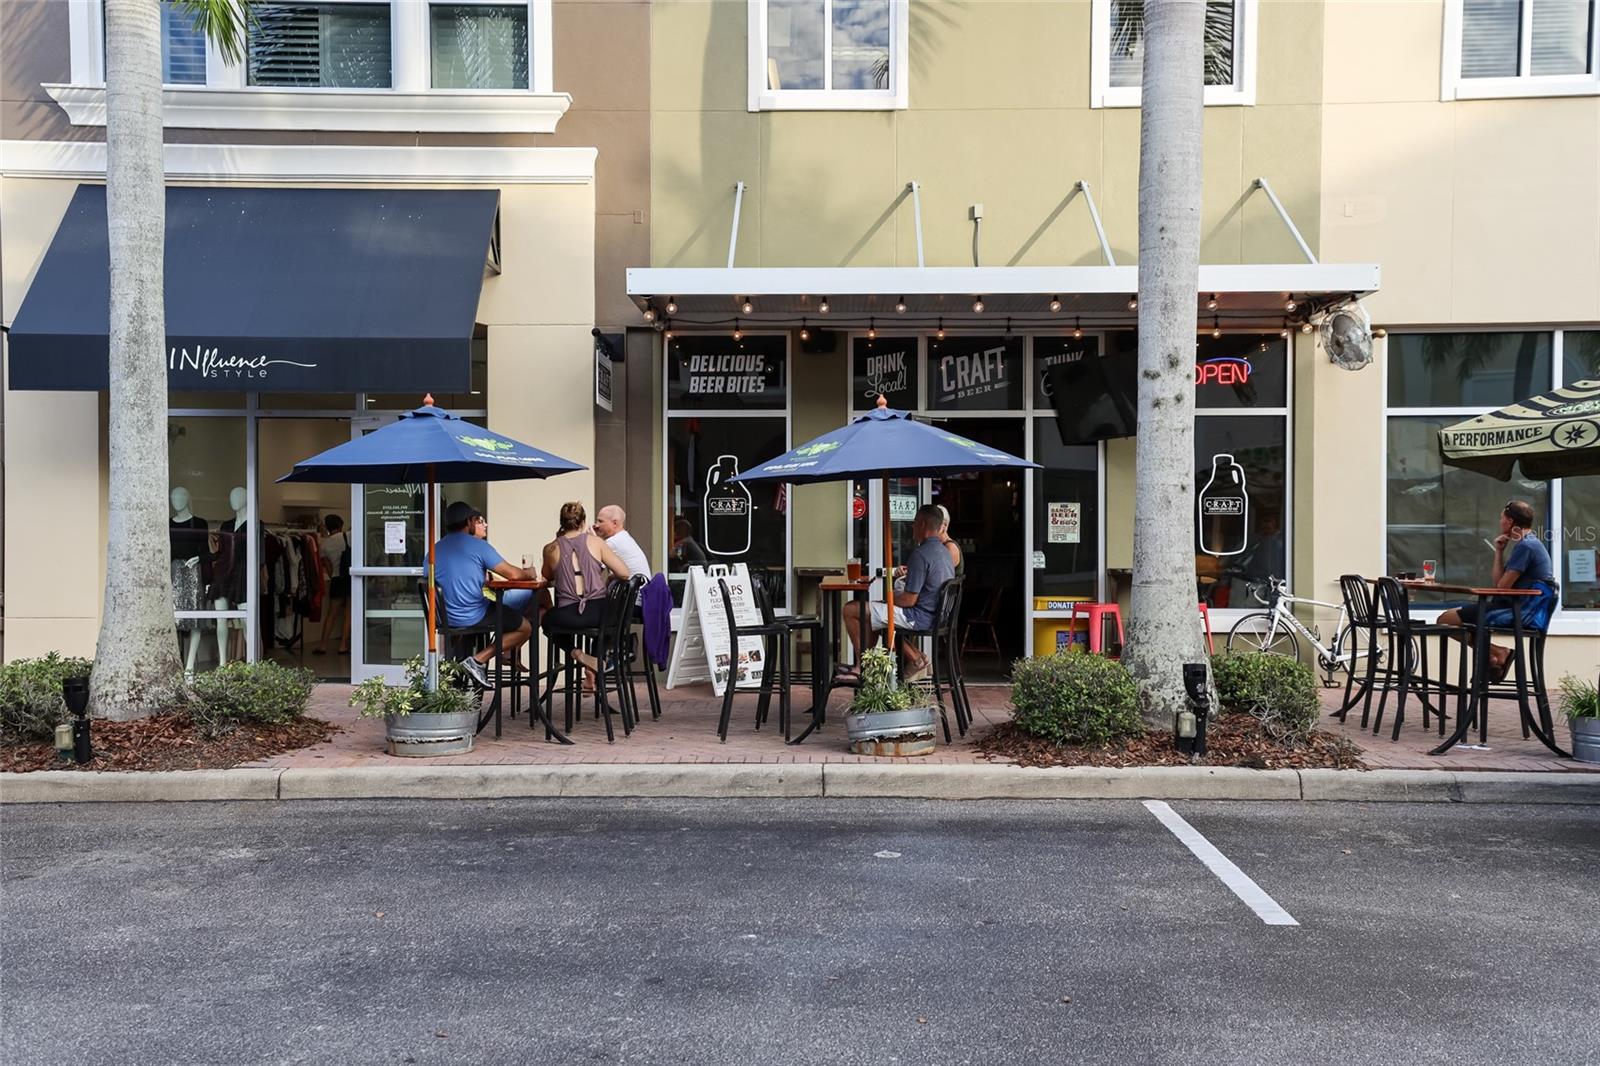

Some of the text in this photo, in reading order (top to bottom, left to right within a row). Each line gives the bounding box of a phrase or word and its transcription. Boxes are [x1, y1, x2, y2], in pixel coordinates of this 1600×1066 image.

[689, 355, 765, 372] DELICIOUS
[866, 351, 906, 377] DRINK
[941, 346, 1006, 392] CRAFT
[689, 376, 766, 393] BEER BITES
[864, 366, 907, 398] Local!
[957, 384, 992, 399] BEER
[1444, 426, 1543, 447] A PERFORMANCE
[1048, 601, 1073, 609] DONATE
